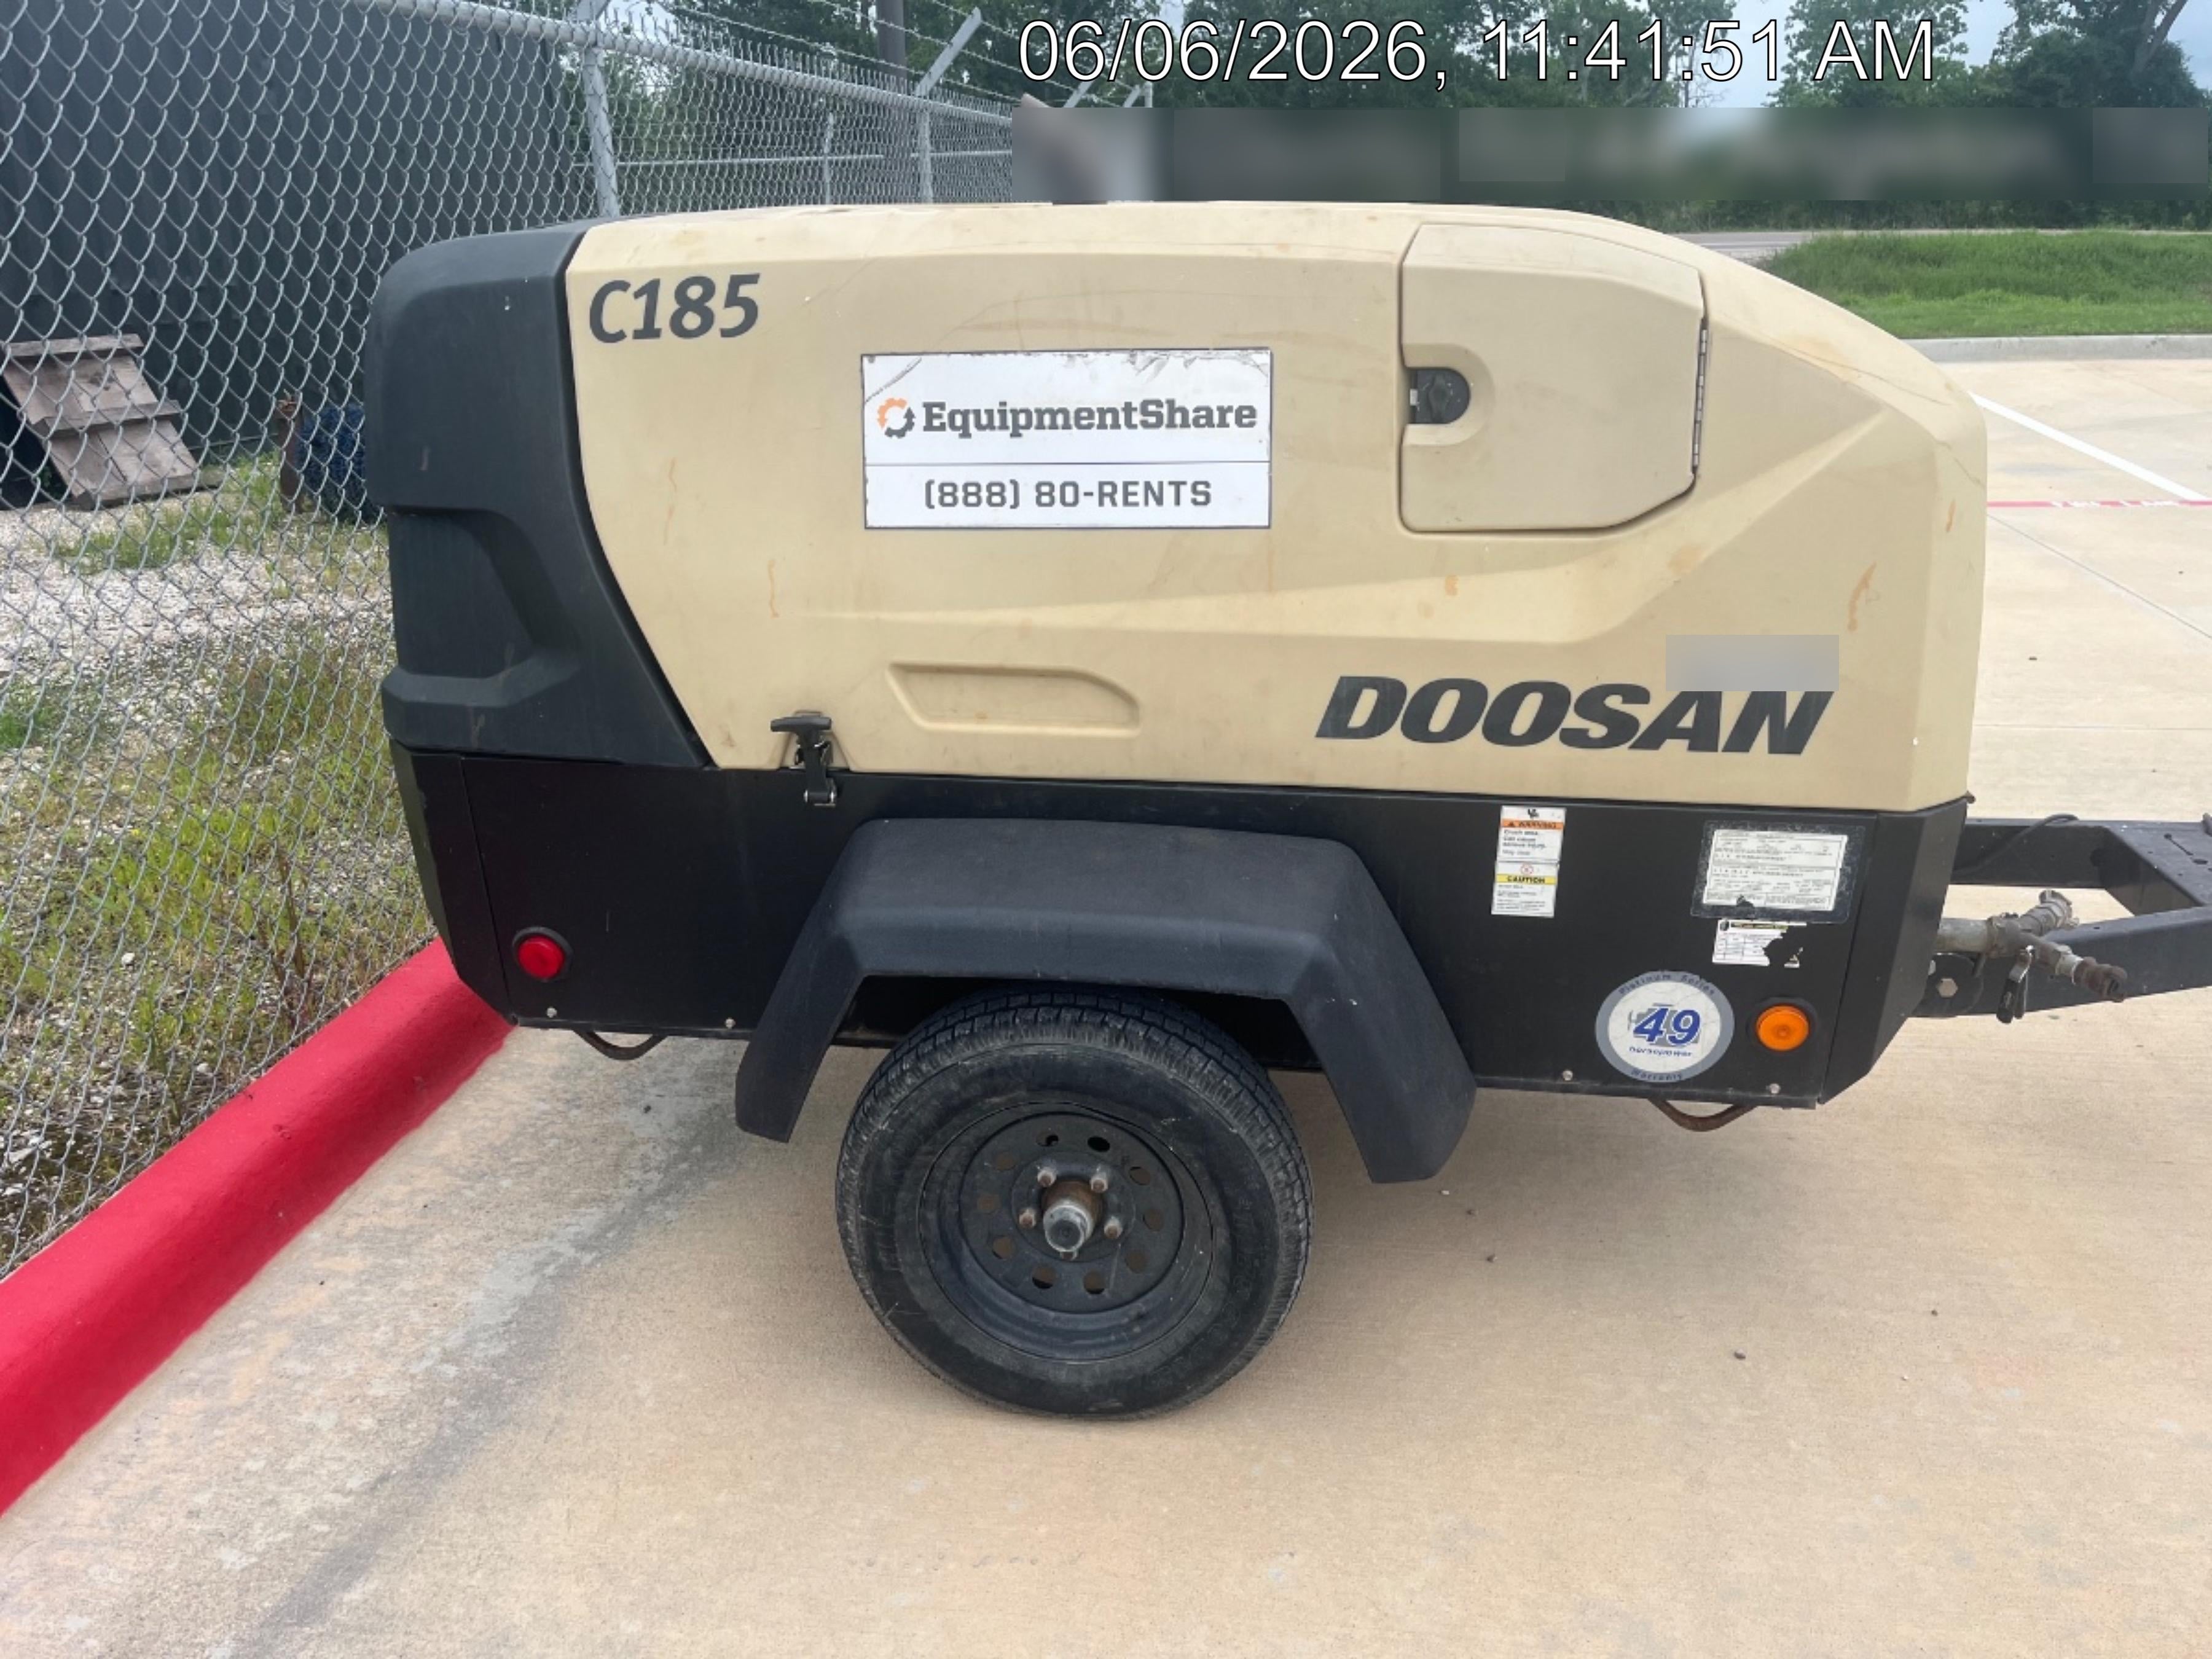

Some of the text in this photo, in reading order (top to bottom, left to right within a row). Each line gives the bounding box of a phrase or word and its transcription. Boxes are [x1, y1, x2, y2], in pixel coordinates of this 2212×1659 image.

[589, 273, 760, 343] C185
[923, 399, 1256, 438] EquipmentShare
[925, 479, 1211, 509] (888) 80-RENTS
[1315, 676, 1835, 755] DOOSAN
[1507, 876, 1546, 884] CAUTION
[1633, 1007, 1701, 1045] 49
